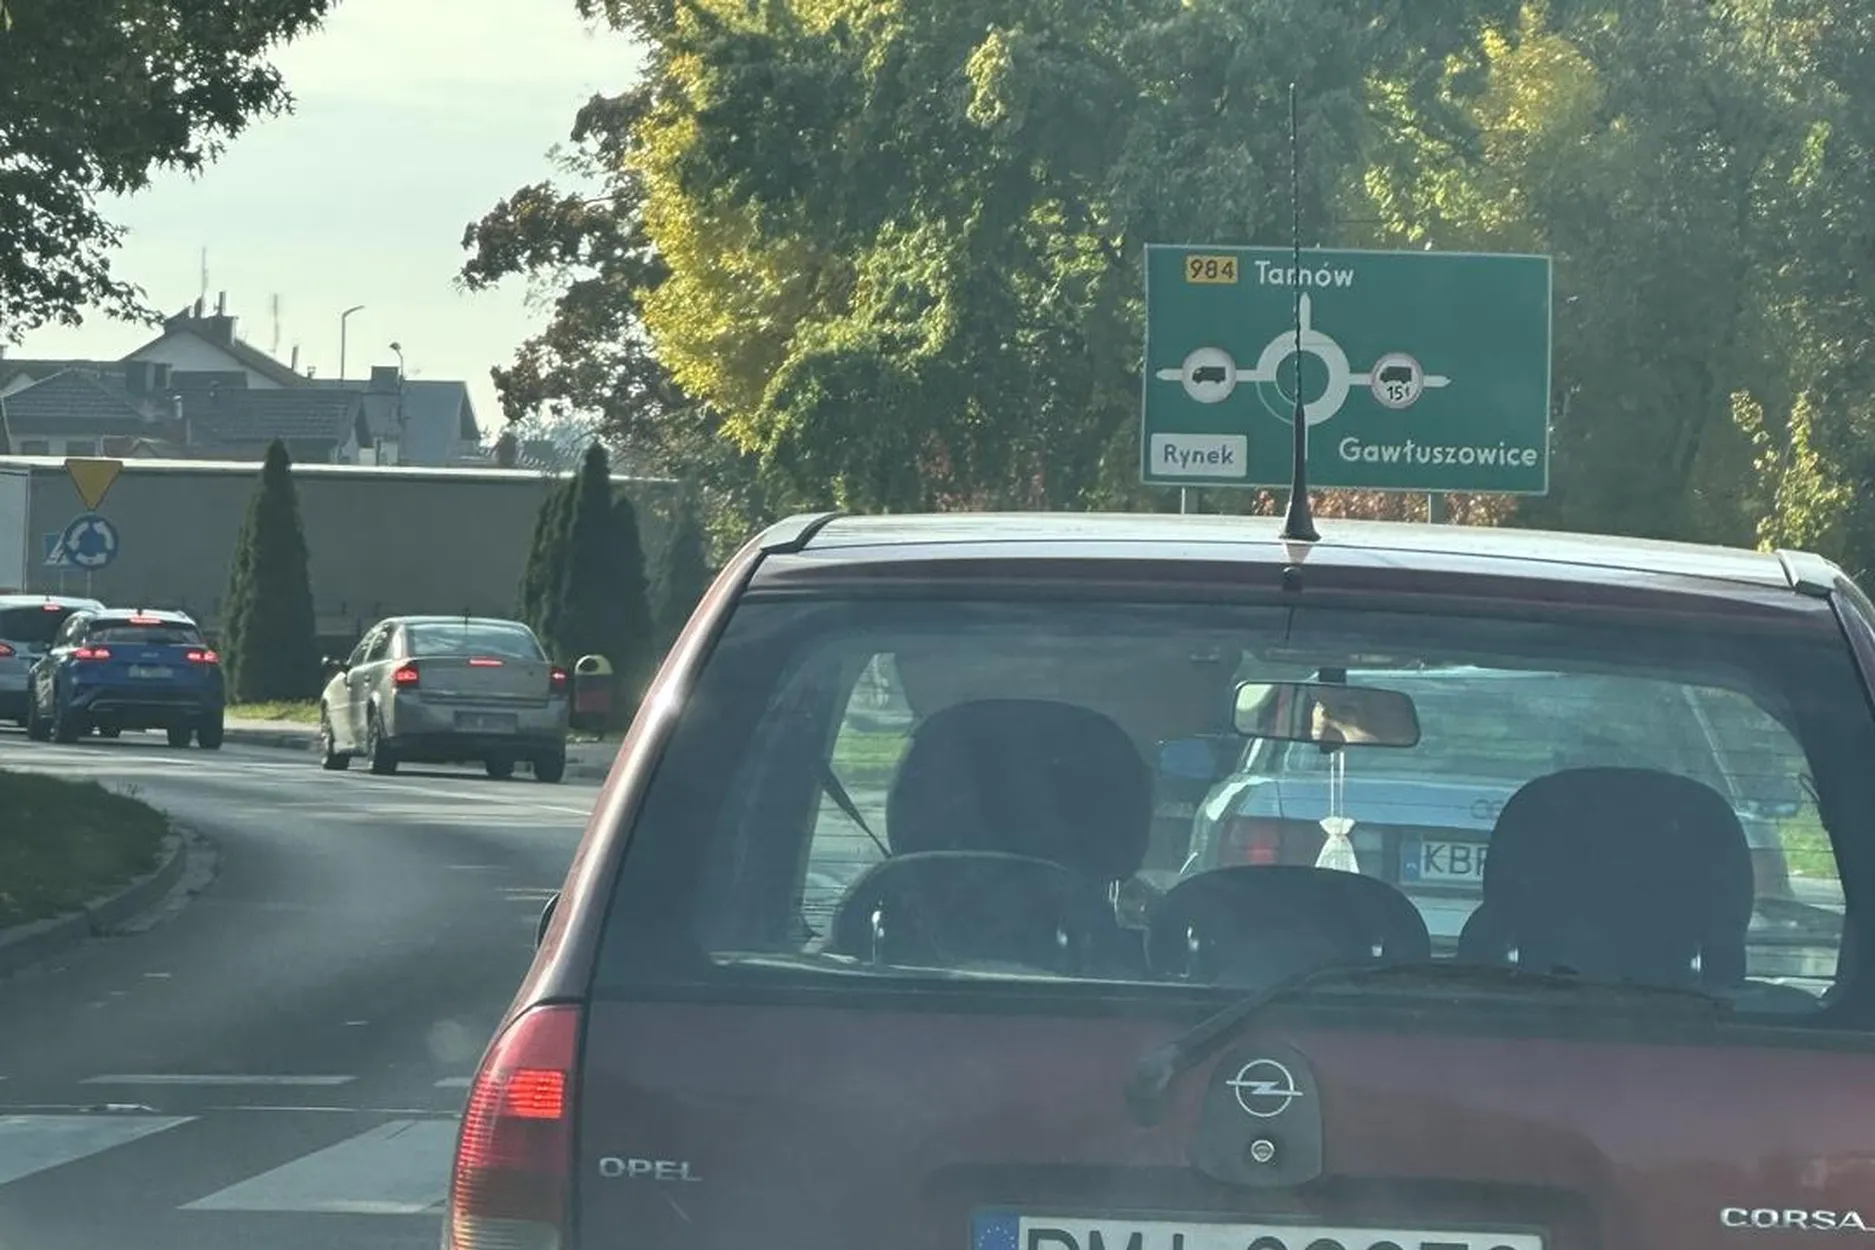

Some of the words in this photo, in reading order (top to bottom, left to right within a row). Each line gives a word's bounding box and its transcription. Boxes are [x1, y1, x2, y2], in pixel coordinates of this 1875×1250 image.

[1190, 259, 1234, 279] 984
[1254, 260, 1354, 287] Tarnów
[1164, 443, 1234, 469] Rynek
[1339, 436, 1538, 467] Gawłuszowice
[599, 1157, 703, 1181] OPEL
[1720, 1207, 1868, 1231] CORSA
